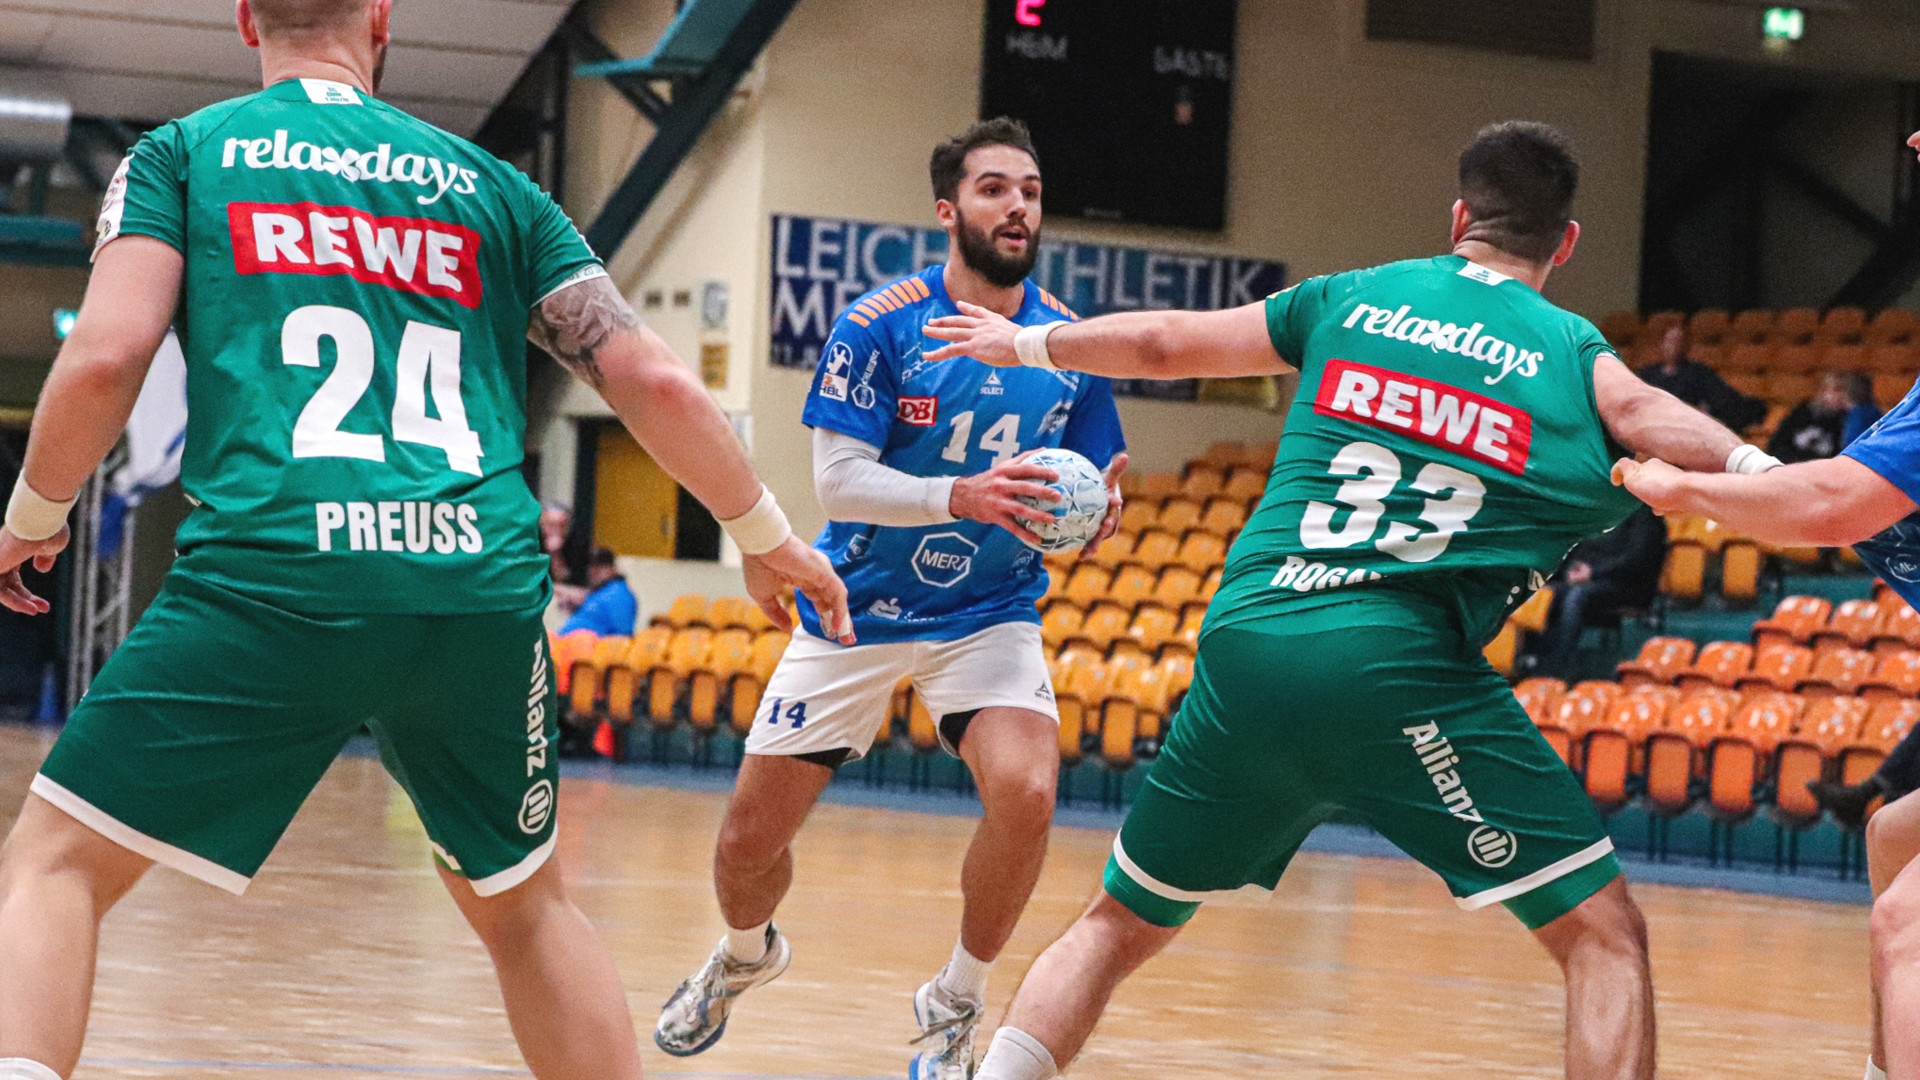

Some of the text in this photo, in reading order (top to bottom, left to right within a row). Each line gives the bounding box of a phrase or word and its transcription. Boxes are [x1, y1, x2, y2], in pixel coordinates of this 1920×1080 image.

[221, 128, 478, 205] relaxdays
[251, 211, 463, 293] REWE
[1342, 302, 1543, 385] relaxdays
[281, 303, 484, 477] 24
[900, 401, 931, 422] DB
[979, 387, 1004, 396] SELECT
[1331, 369, 1513, 462] REWE
[941, 410, 1021, 468] 14
[315, 500, 483, 553] PREUSS
[1300, 441, 1487, 562] 33
[1269, 554, 1382, 592] ROGA
[768, 697, 807, 729] 14
[1402, 720, 1485, 823] Allianz
